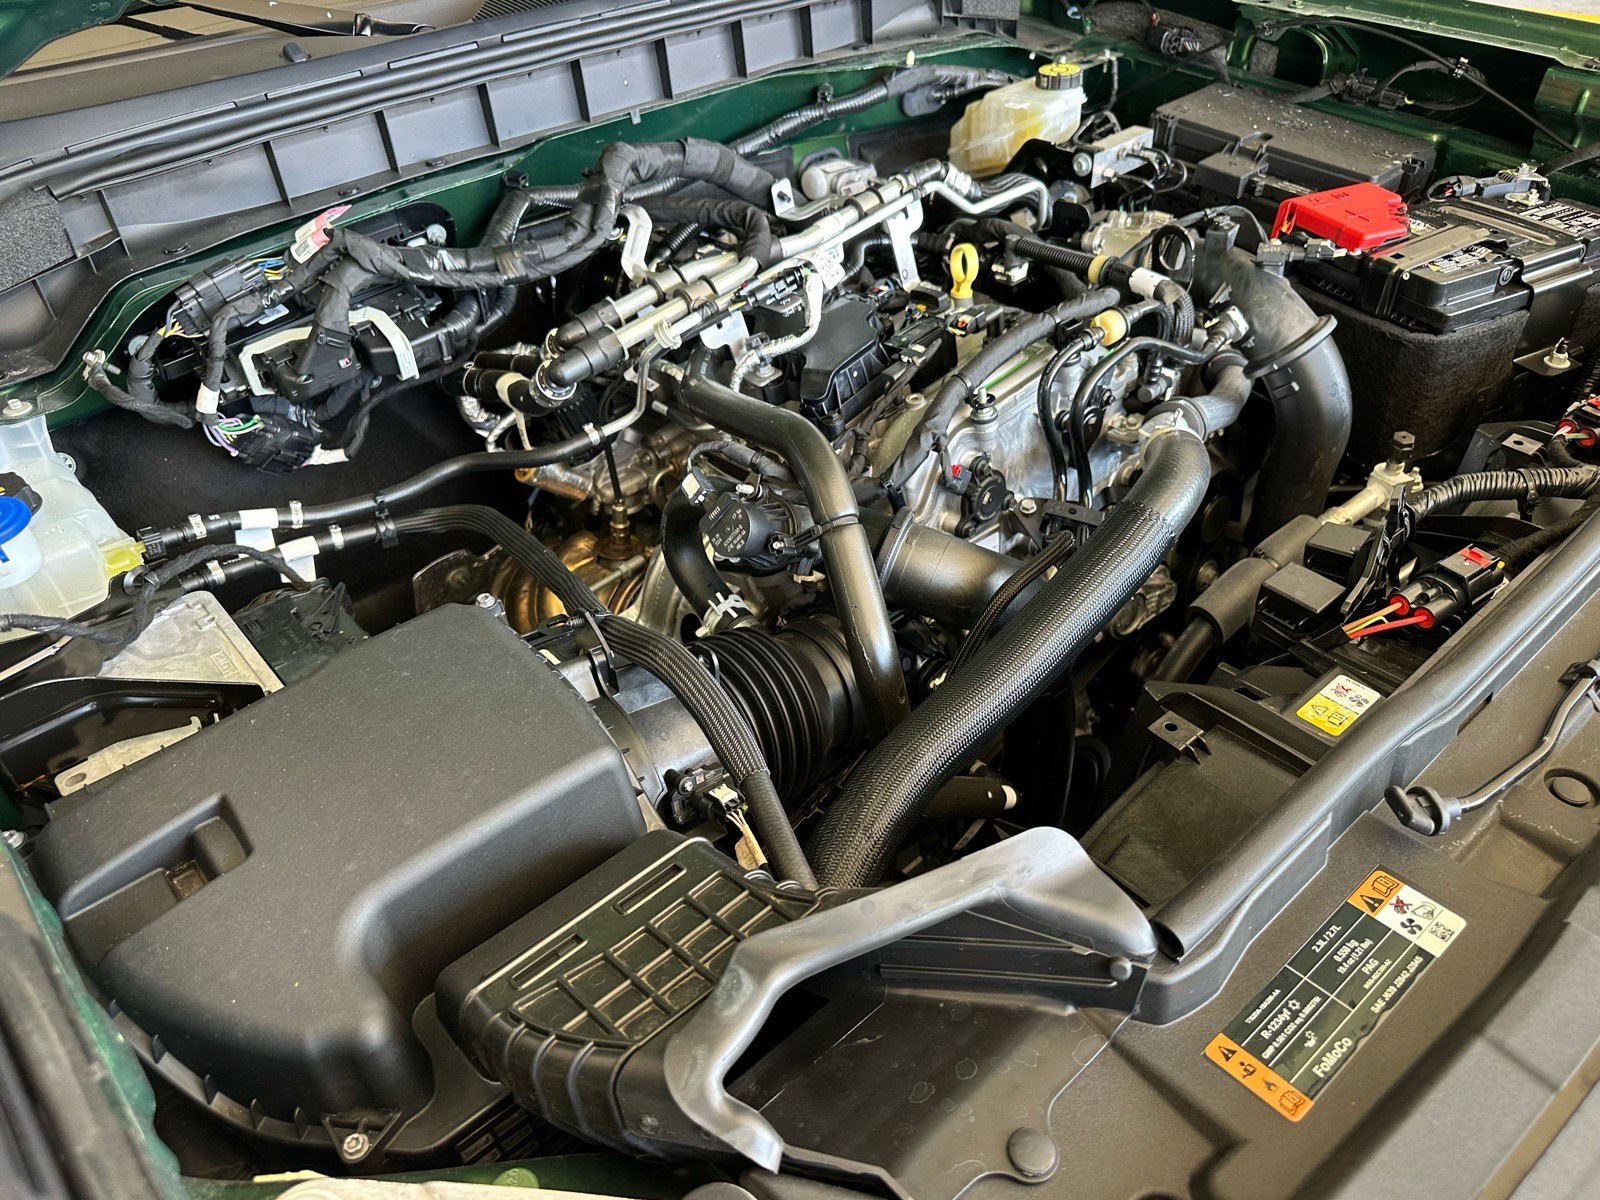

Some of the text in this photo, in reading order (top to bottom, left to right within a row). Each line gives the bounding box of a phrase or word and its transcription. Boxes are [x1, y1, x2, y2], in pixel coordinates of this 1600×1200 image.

[1311, 937, 1328, 953] 2.3L
[1327, 924, 1342, 938] 2.7L
[1332, 937, 1359, 962] 0.550 kg
[1336, 961, 1350, 974] 19.4
[1360, 956, 1379, 975] PAG
[1370, 998, 1386, 1013] SAE
[1381, 984, 1397, 1000] J639
[1392, 968, 1411, 987] J2842
[1259, 1007, 1291, 1039] R-1234yf
[1283, 1021, 1297, 1035] CO2
[1312, 1036, 1352, 1077] FoMoCo
